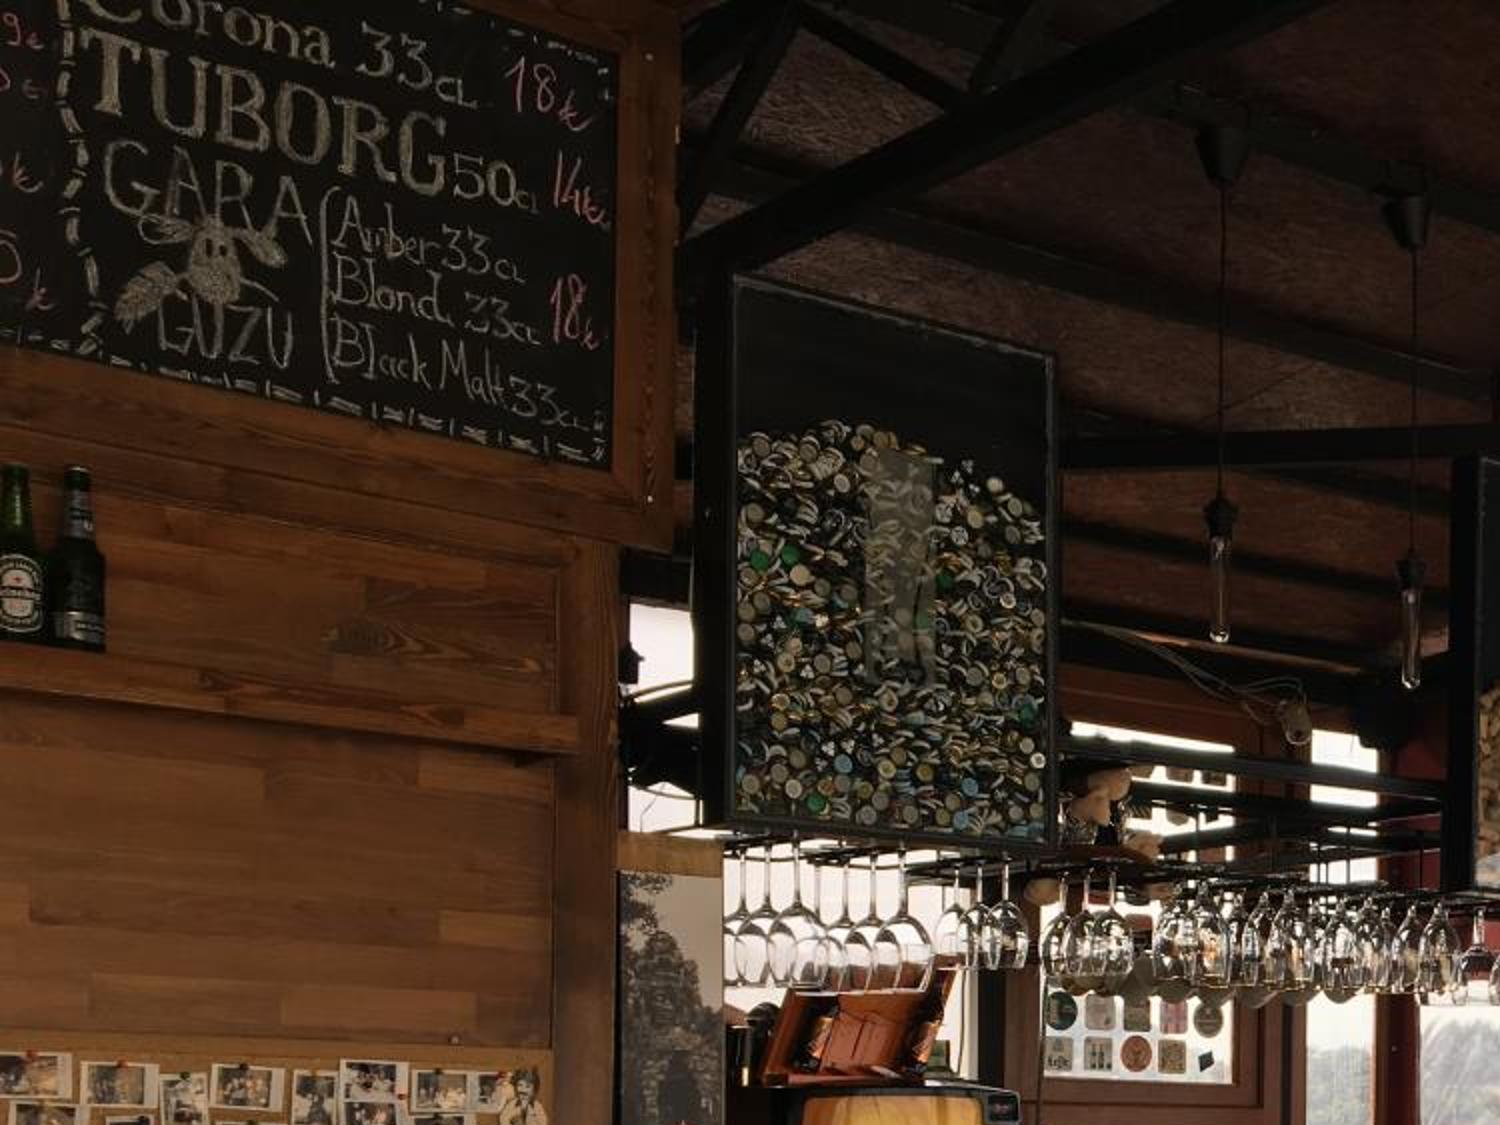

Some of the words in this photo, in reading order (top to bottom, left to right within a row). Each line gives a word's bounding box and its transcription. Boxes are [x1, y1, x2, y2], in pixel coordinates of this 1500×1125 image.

[80, 26, 448, 196] TUBORG
[103, 139, 313, 250] GARA
[157, 290, 295, 369] GUZU
